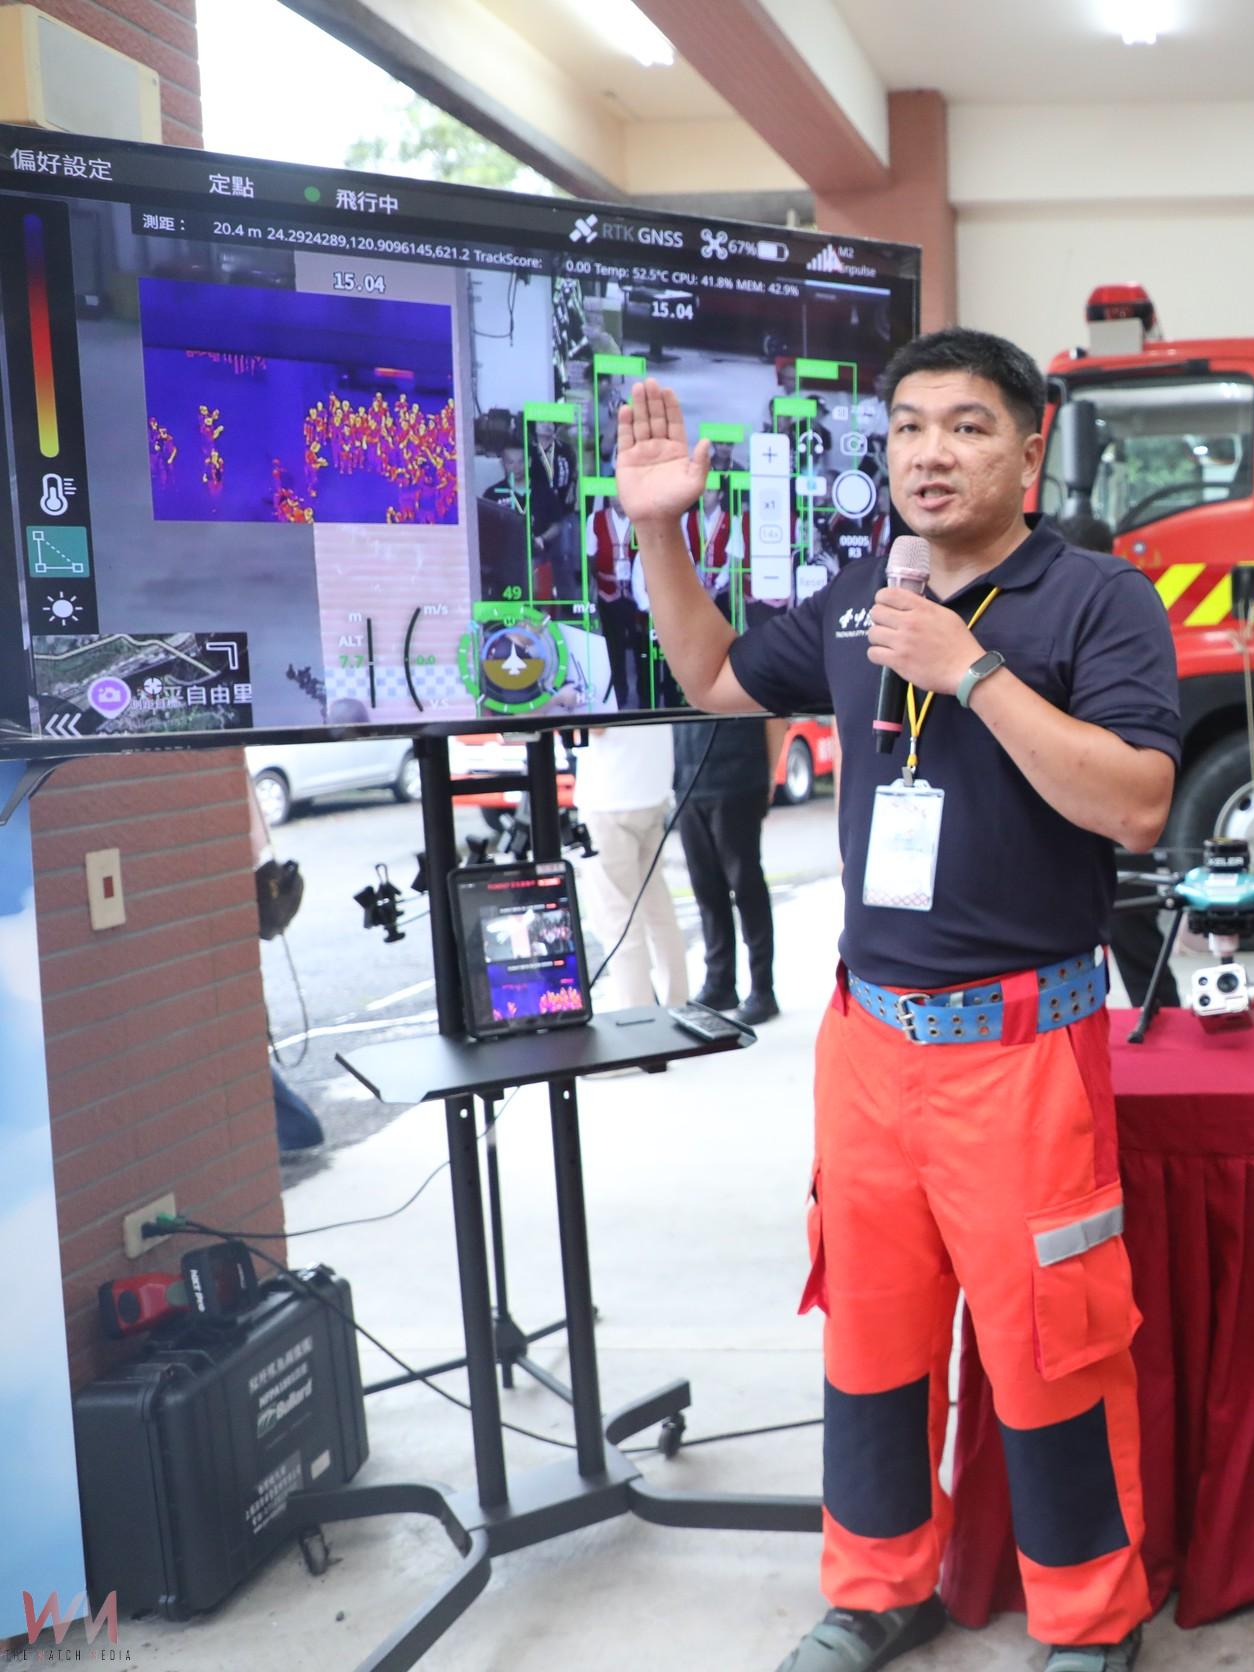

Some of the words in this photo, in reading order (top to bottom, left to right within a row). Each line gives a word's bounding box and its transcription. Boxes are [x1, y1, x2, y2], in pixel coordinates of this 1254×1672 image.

[10, 147, 113, 181] 偏好設定
[208, 173, 254, 199] 定點
[335, 188, 399, 215] 飛行中
[602, 222, 634, 242] RTK
[638, 227, 684, 248] GNSS
[728, 240, 757, 256] 67%
[213, 221, 244, 237] 20.4
[247, 226, 262, 238] m
[474, 250, 543, 269] TrackScore:
[566, 260, 591, 273] 0.00
[595, 263, 629, 279] Temp:
[672, 271, 698, 286] CPU:
[736, 280, 765, 293] MEM:
[768, 283, 799, 297] 42.9%
[333, 272, 385, 293] 15.04
[652, 302, 694, 320] 15.04
[502, 585, 522, 600] 49
[423, 604, 449, 616] m/s
[339, 635, 364, 648] ALT
[339, 655, 365, 669] 7.7
